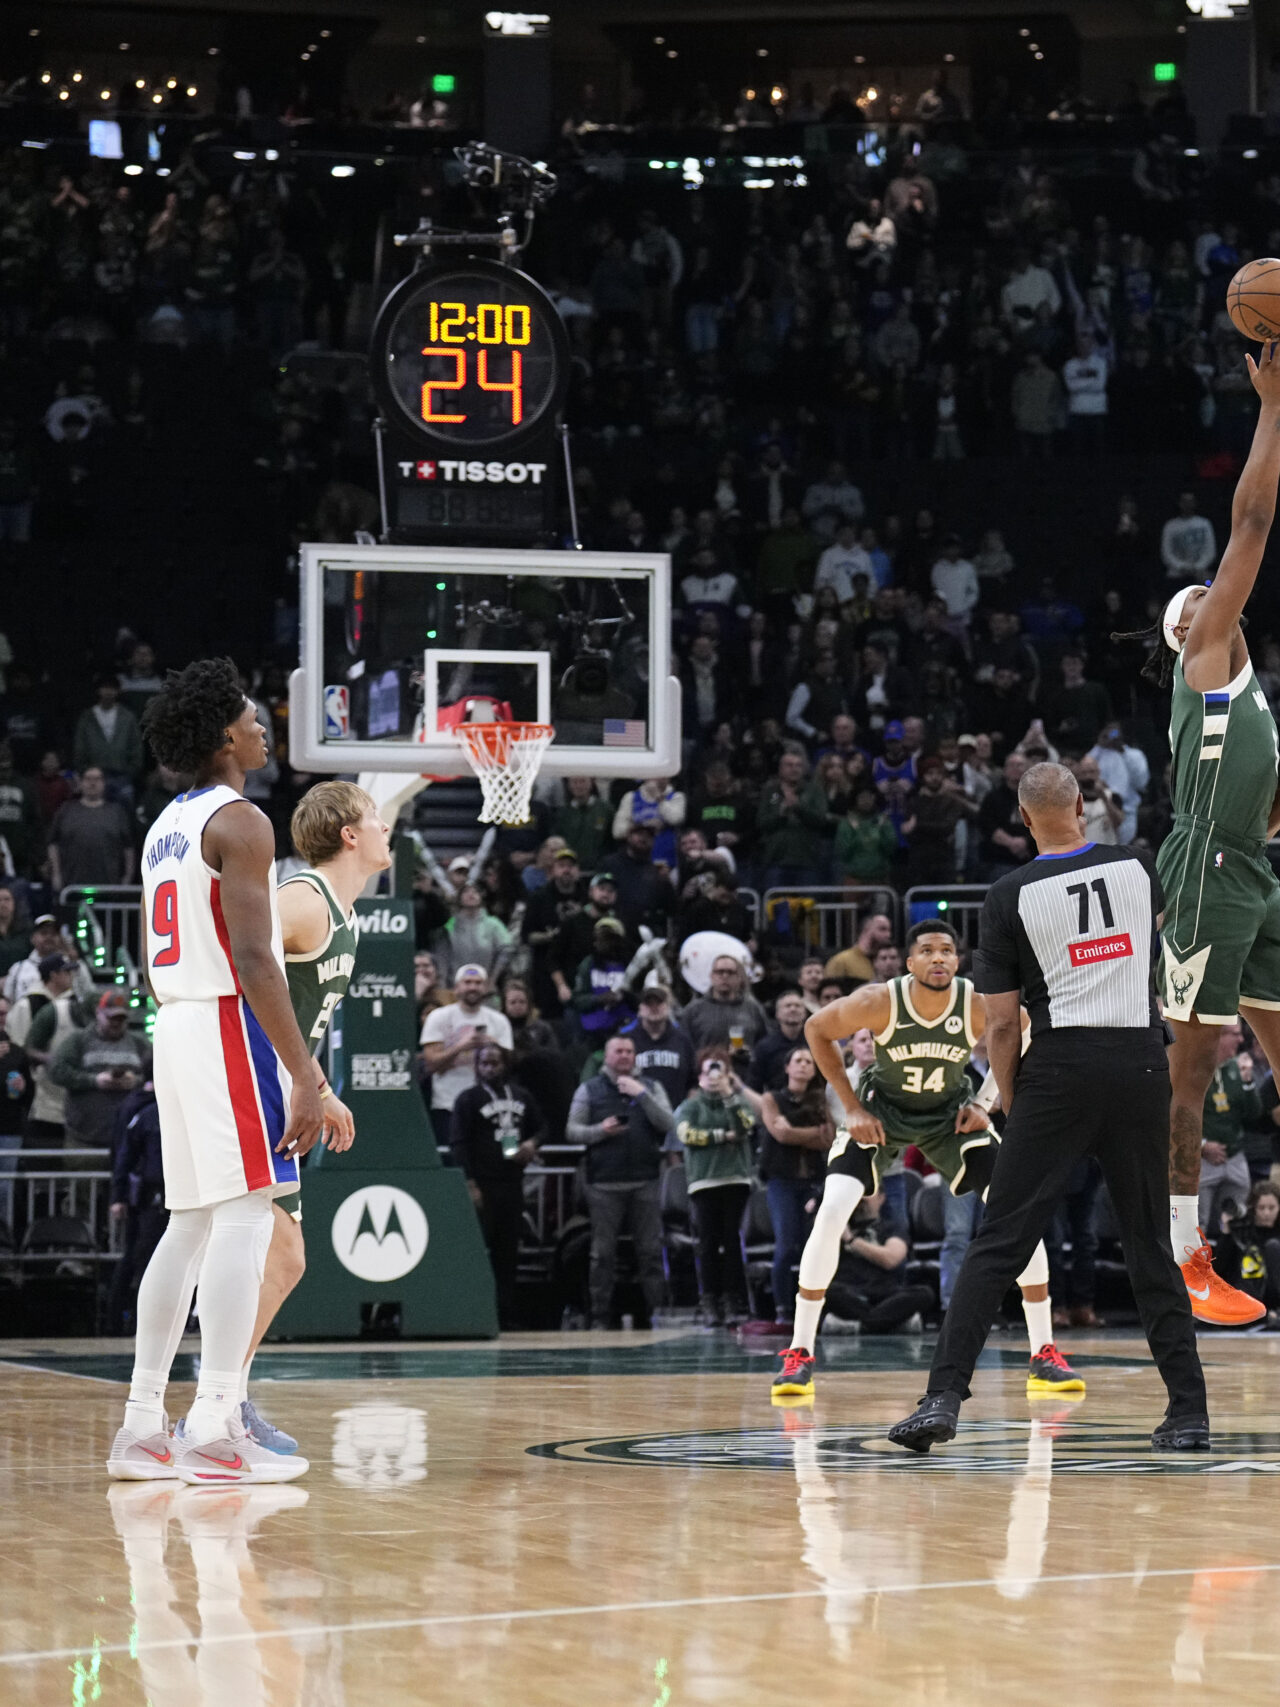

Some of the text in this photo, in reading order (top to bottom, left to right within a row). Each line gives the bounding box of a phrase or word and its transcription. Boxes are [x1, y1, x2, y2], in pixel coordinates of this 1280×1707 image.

[430, 302, 530, 345] 12:00
[421, 347, 522, 425] 24
[438, 461, 547, 484] TISSOT
[146, 831, 190, 872] THOMPSON
[1066, 877, 1114, 934] 71
[152, 879, 181, 967] 9
[1075, 941, 1127, 960] Emirates
[349, 984, 408, 998] ULTRA
[886, 1042, 968, 1063] MILWAUKEE
[901, 1066, 945, 1093] 34
